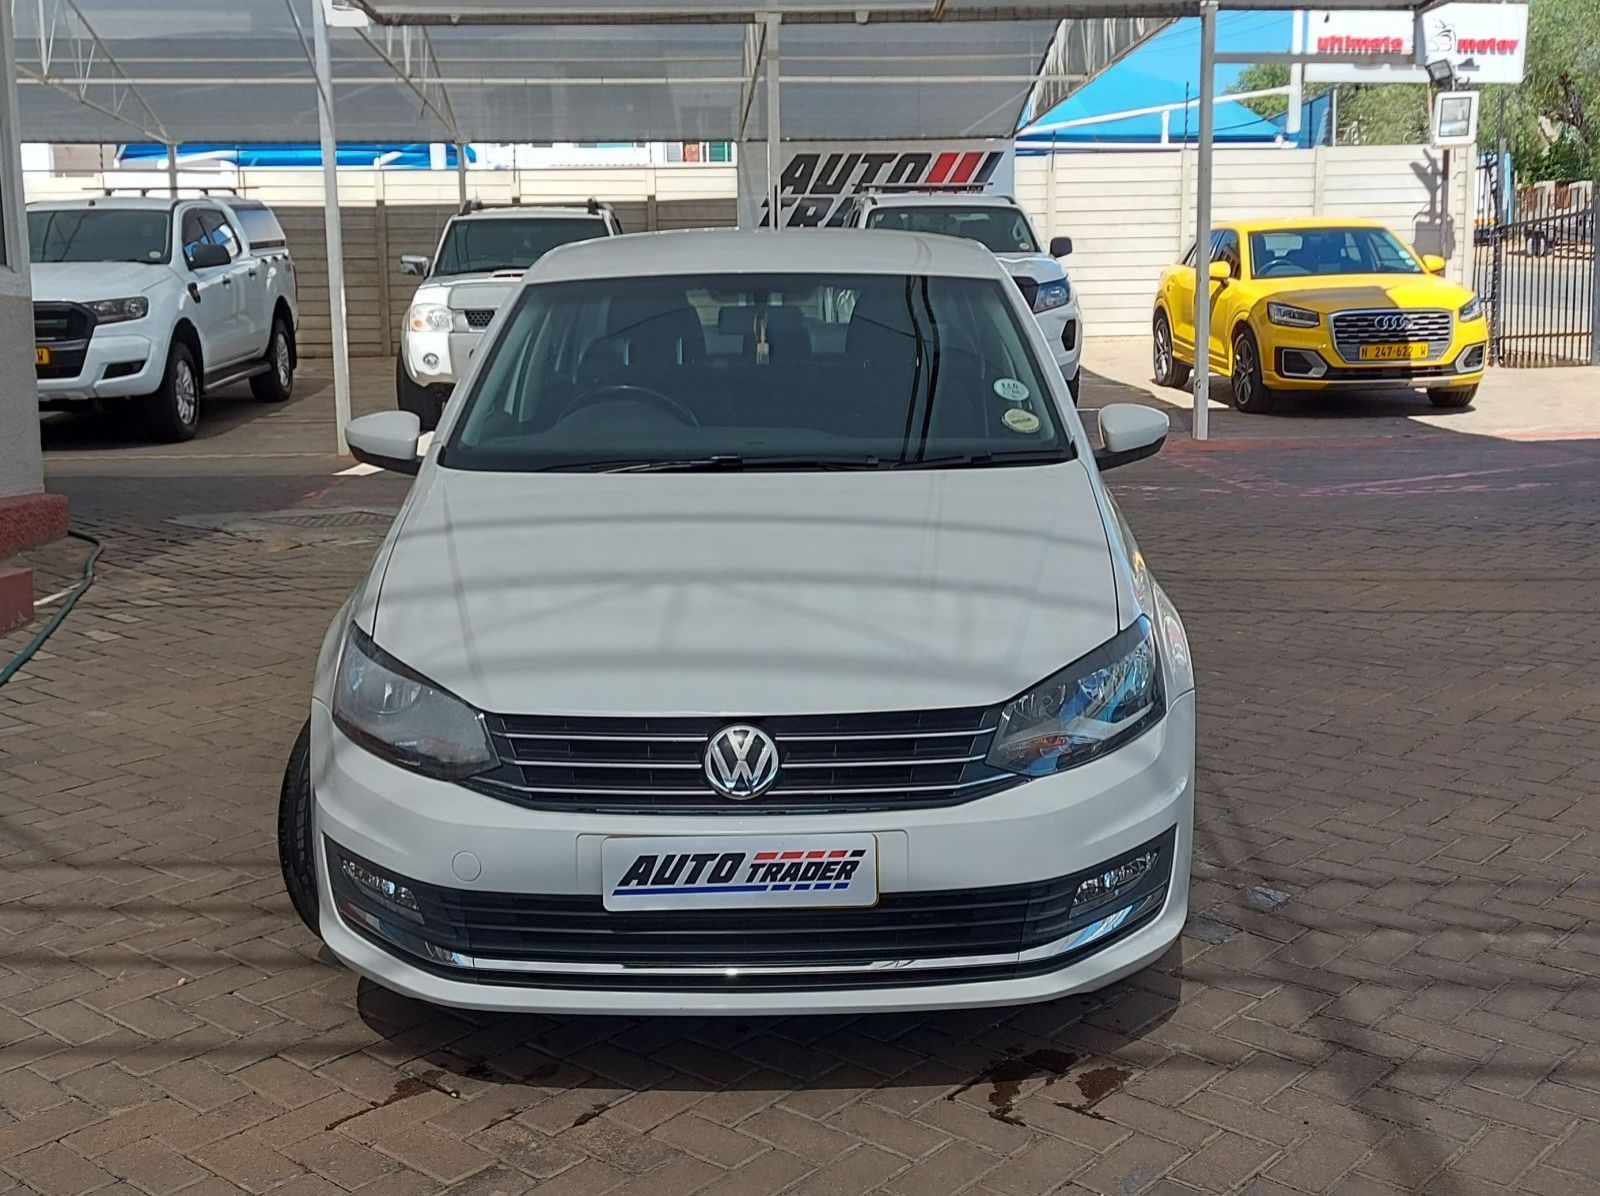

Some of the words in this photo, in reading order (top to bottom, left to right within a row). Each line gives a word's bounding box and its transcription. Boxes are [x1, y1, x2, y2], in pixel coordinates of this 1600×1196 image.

[1456, 38, 1520, 55] motor
[780, 153, 932, 195] AUTO
[617, 852, 747, 887] AUTO
[745, 860, 861, 884] TRADER
